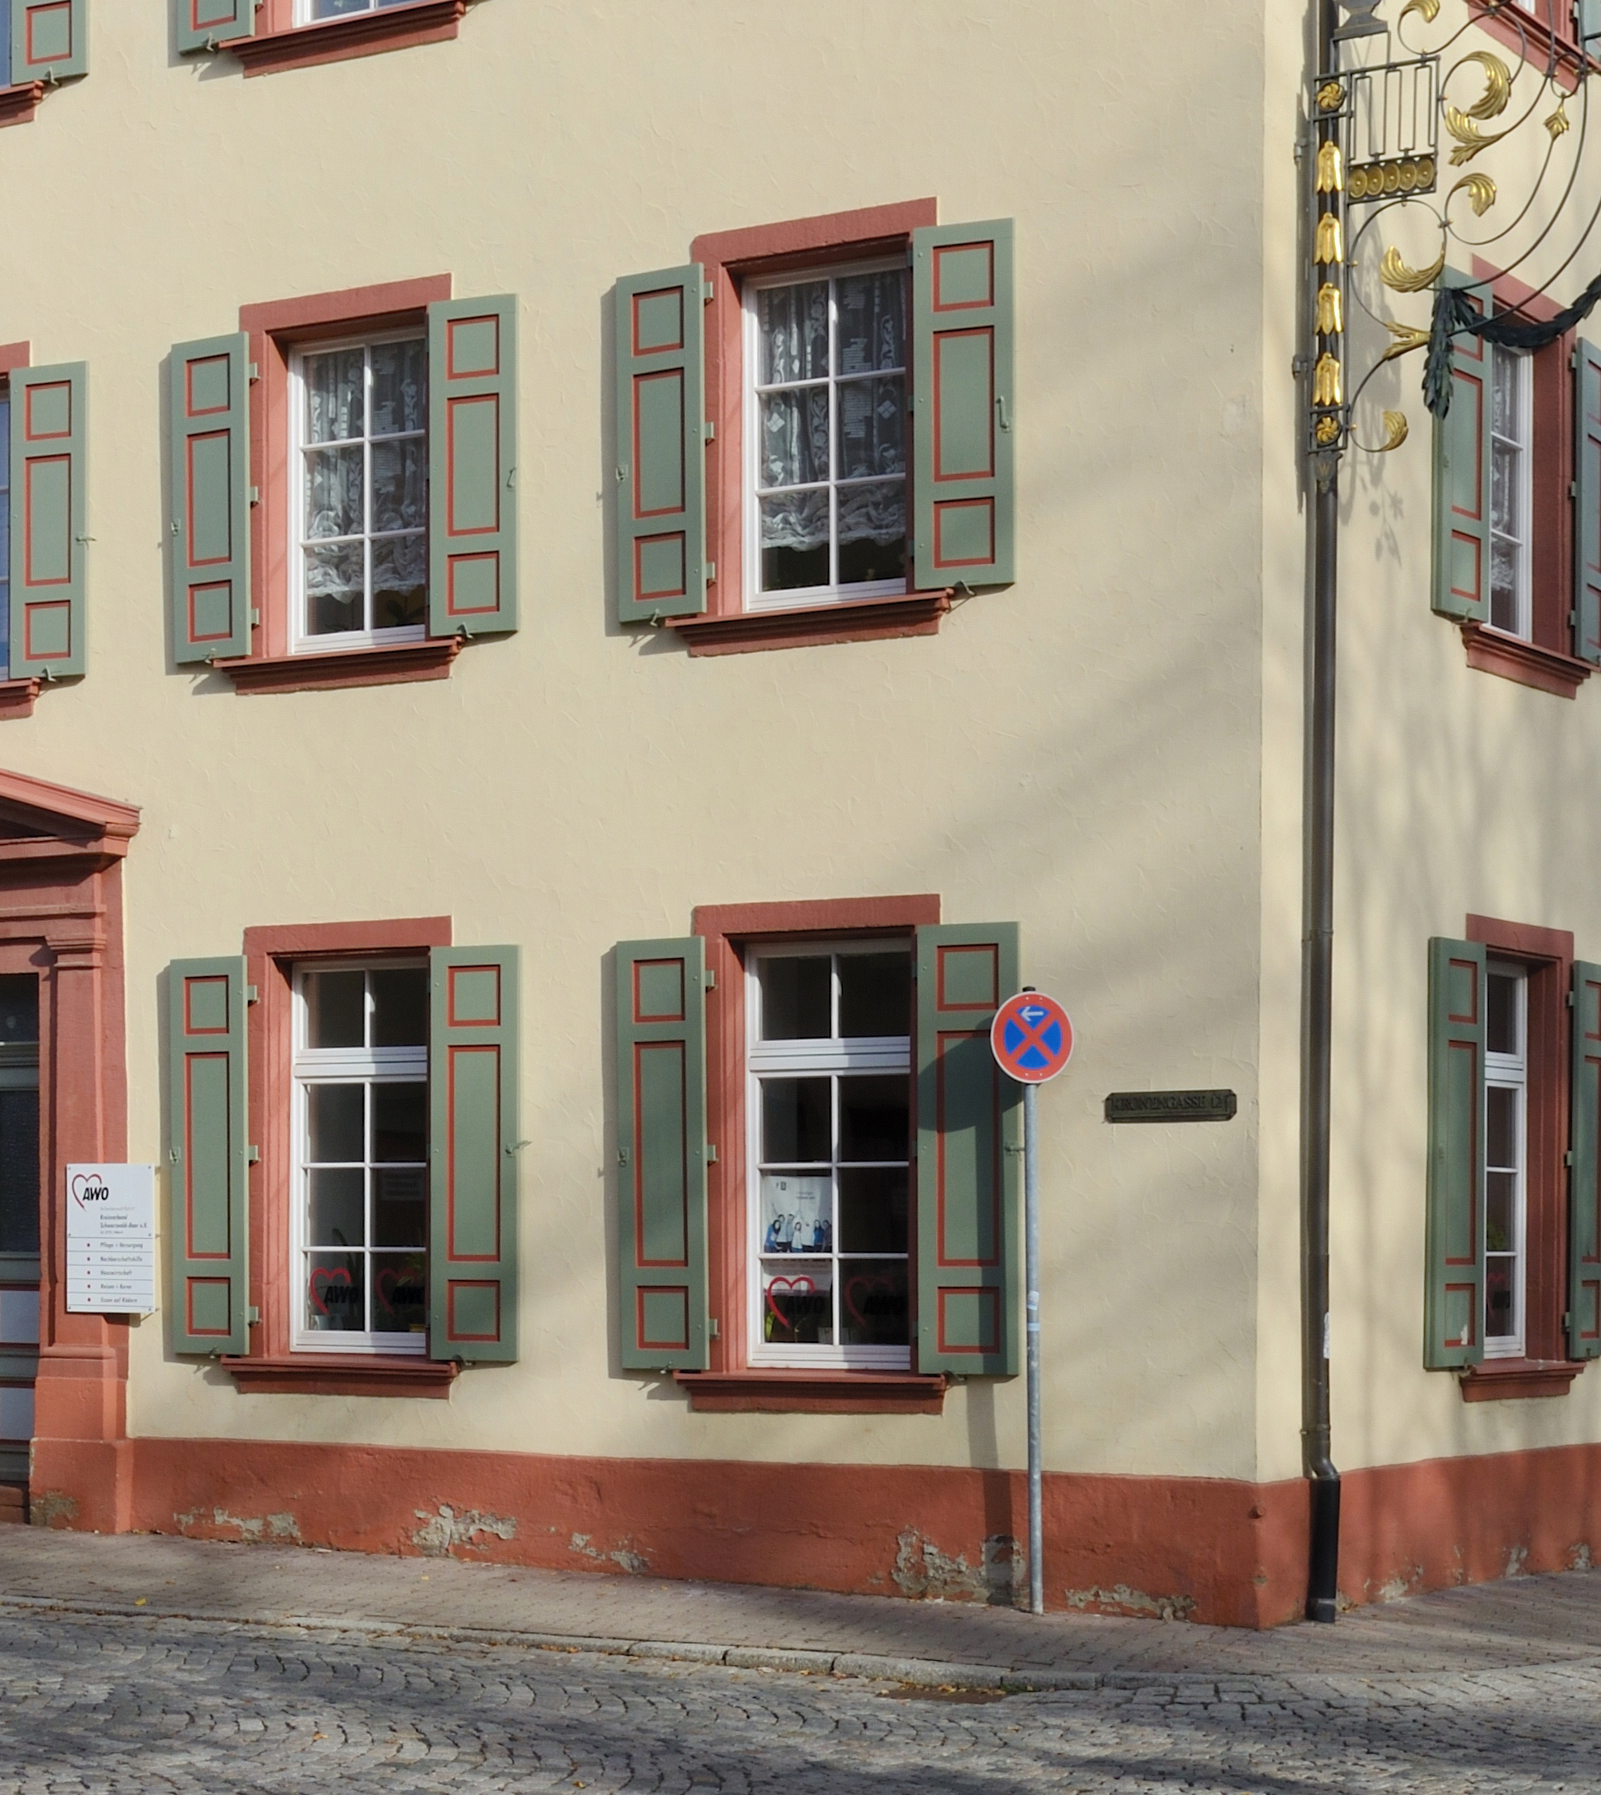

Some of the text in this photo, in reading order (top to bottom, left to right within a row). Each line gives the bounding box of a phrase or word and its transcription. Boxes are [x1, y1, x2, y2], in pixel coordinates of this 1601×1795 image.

[82, 1186, 109, 1201] AWO
[324, 1285, 359, 1304] AWO
[784, 1295, 825, 1315] AWO
[863, 1295, 906, 1315] AWO
